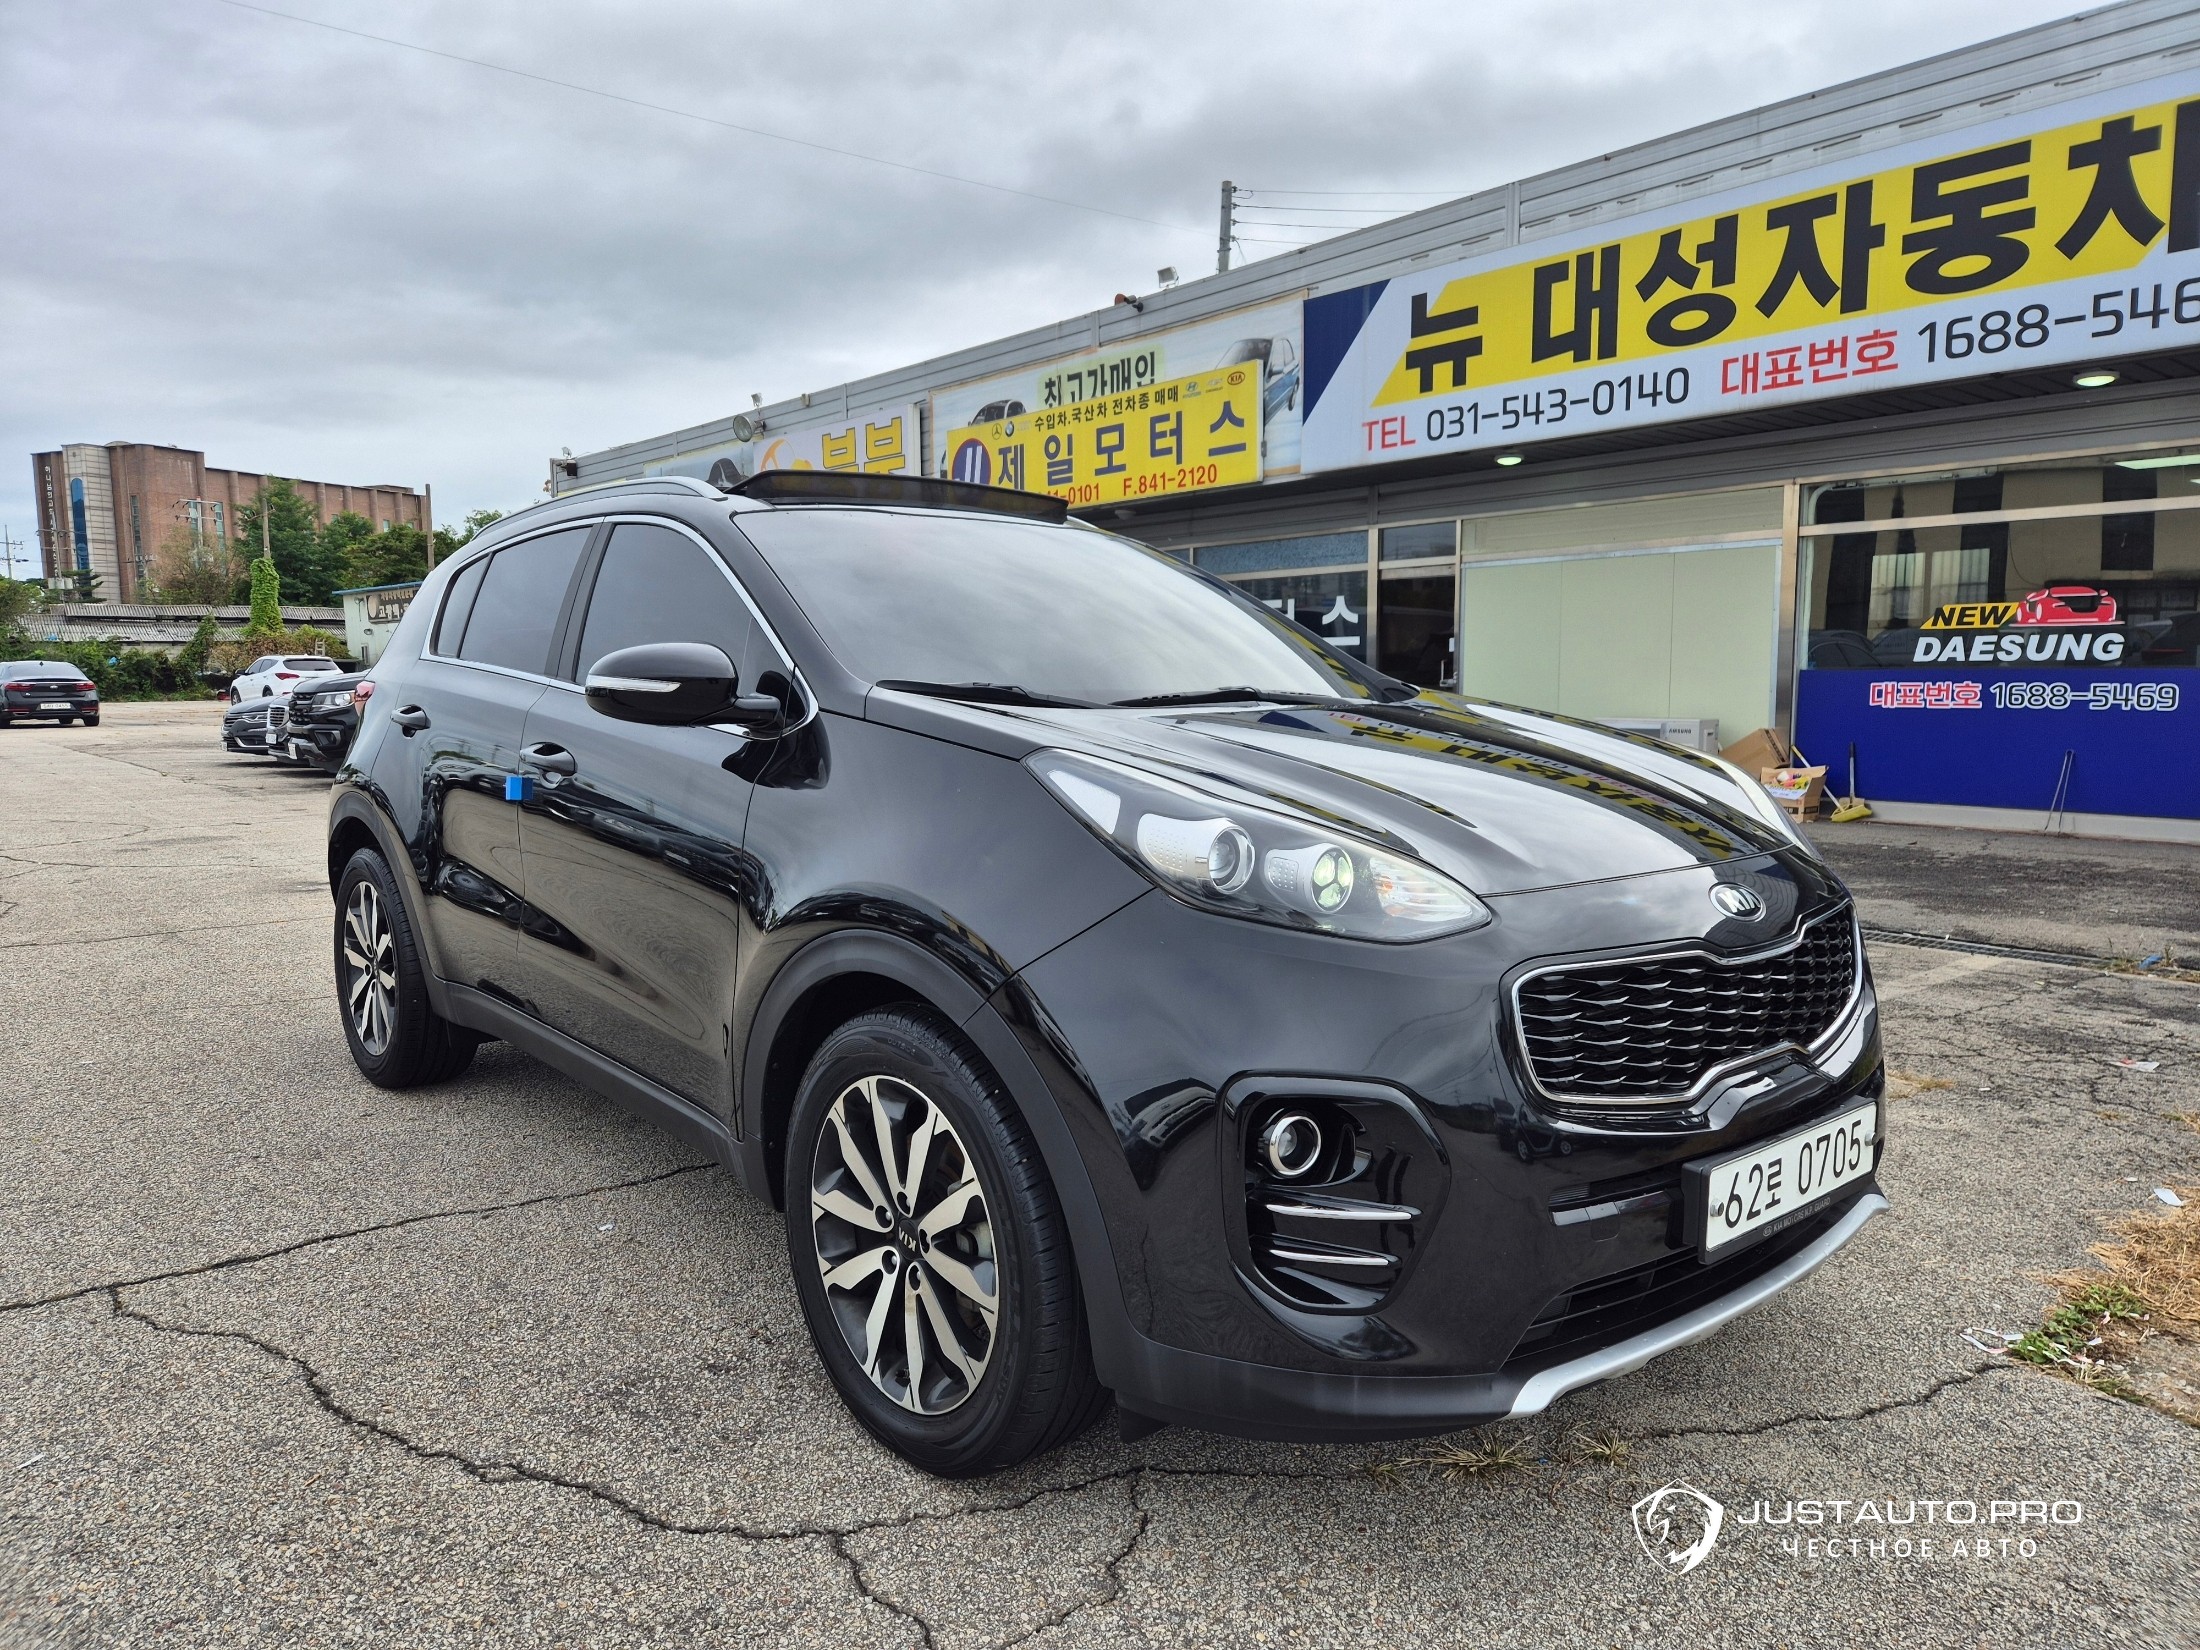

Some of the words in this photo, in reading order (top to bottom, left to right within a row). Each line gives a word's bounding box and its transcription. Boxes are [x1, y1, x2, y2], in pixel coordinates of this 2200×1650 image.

[1405, 292, 1484, 394] 뉴
[1721, 328, 1899, 396] 대표번호
[1112, 392, 1151, 416] 전차종
[1154, 384, 1179, 406] 매매
[1362, 415, 1416, 451] TEL
[1426, 367, 1690, 441] 031-543-0140
[1122, 463, 1217, 496] F.841-2120
[1931, 604, 2012, 628] NEW
[1913, 632, 2125, 663] DAESUNG
[1869, 681, 1982, 709] 대표번호
[1990, 682, 2180, 712] 1688-5469
[1717, 887, 1761, 913] KIA
[1724, 1156, 1782, 1229] 62로
[1798, 1118, 1862, 1196] 0705
[1814, 1197, 1831, 1212] GUARD
[898, 1225, 917, 1252] KIA
